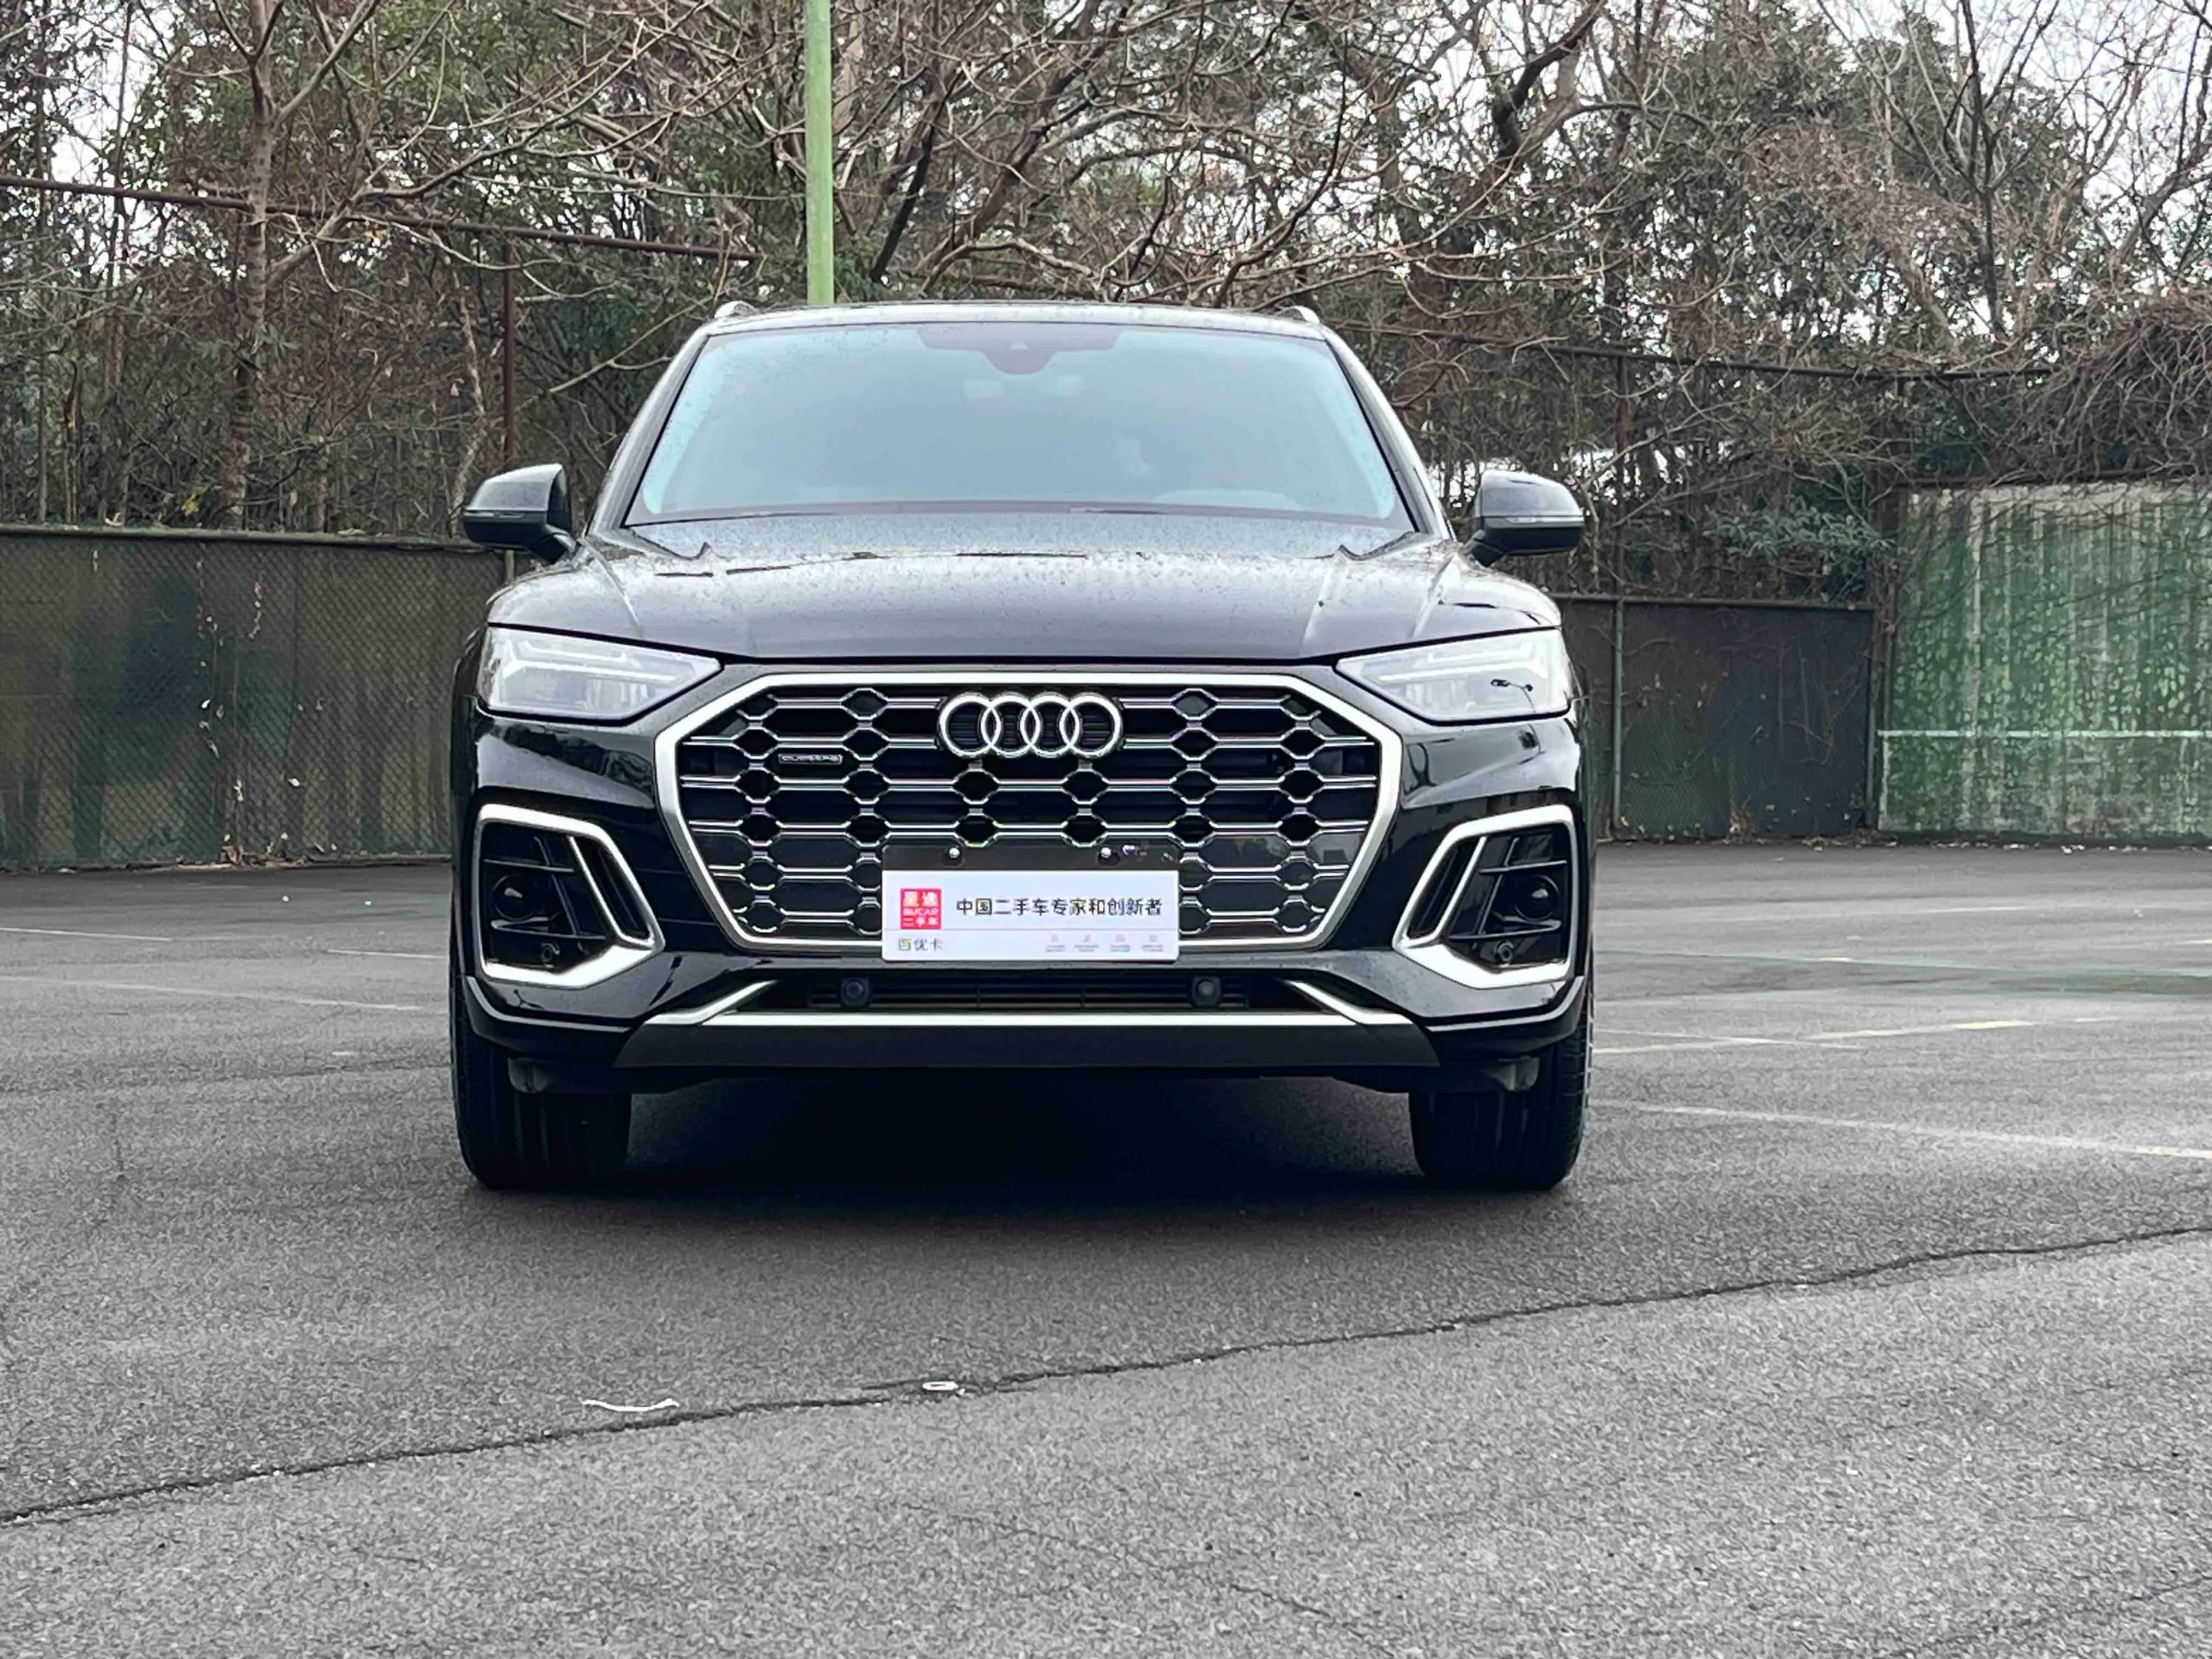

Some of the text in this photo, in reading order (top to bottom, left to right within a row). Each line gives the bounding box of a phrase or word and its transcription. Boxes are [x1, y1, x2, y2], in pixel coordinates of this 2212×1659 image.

[956, 897, 1162, 916] 中国二手车专家和创新者
